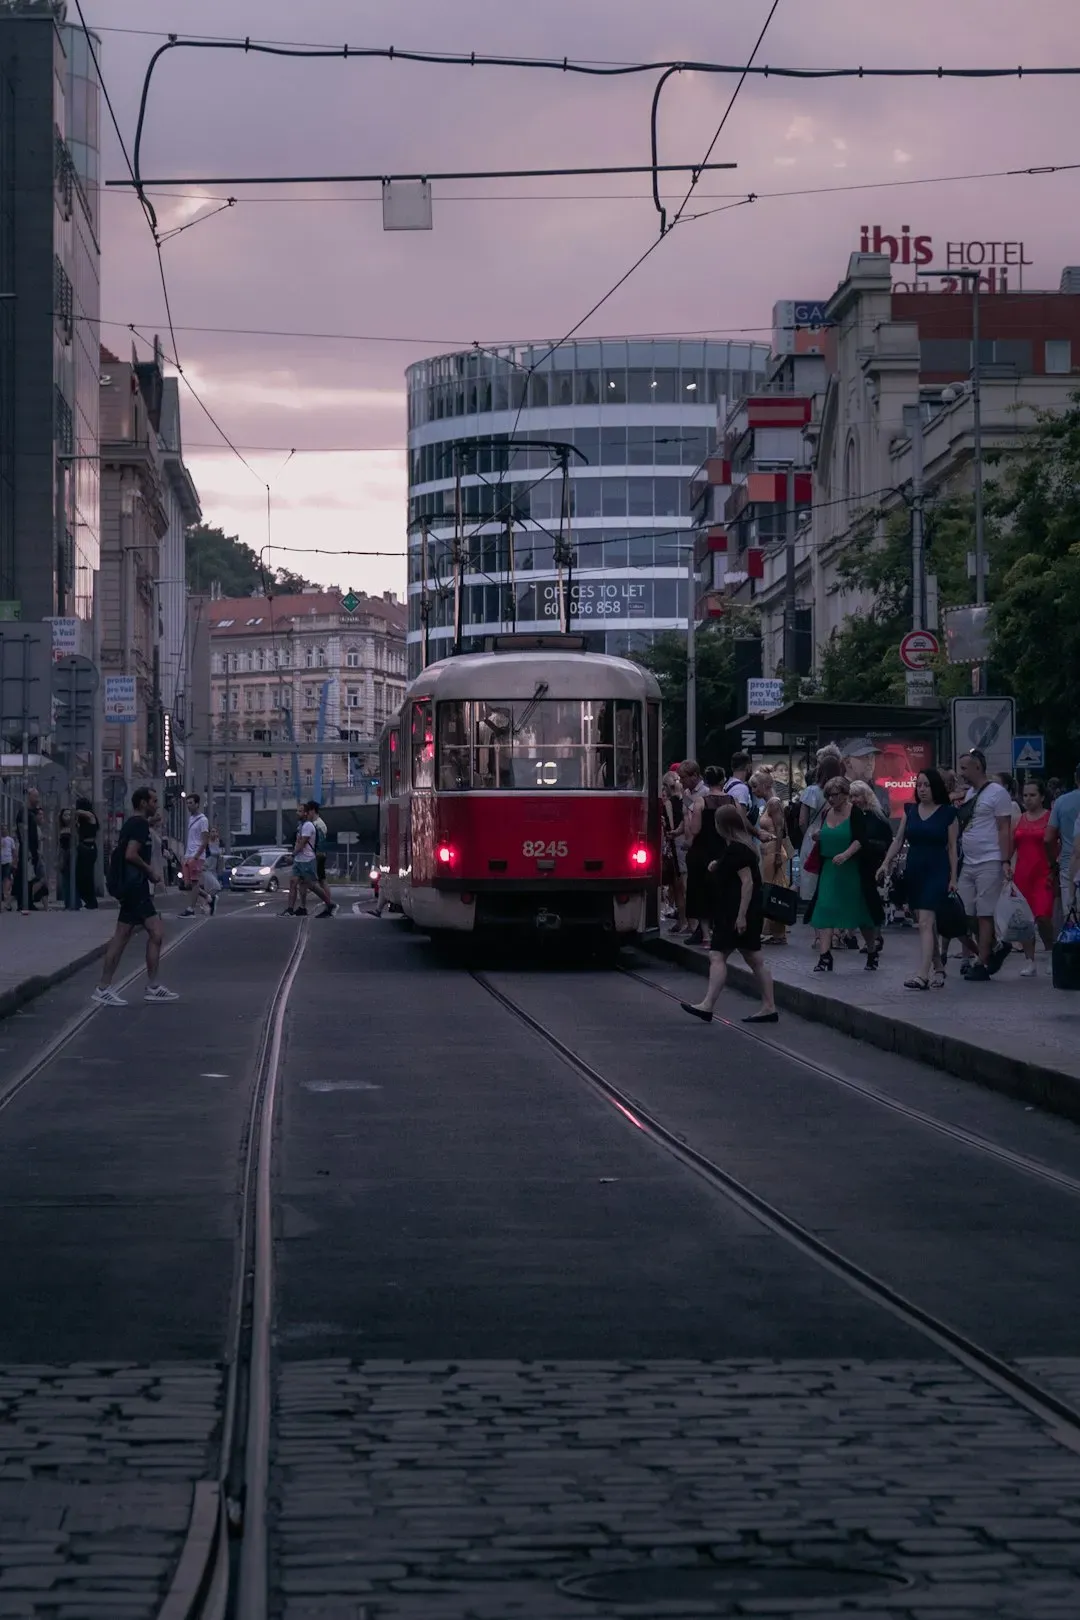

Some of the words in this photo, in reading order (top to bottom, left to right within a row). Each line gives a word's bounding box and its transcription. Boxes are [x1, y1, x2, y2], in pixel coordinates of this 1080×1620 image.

[860, 225, 934, 265] ibis
[946, 241, 1034, 265] HOTEL
[543, 585, 595, 600] OFFCES
[597, 585, 618, 599] TO
[621, 584, 646, 598] LET
[569, 601, 594, 615] 056
[597, 600, 622, 614] 858
[750, 691, 764, 699] pro
[535, 761, 559, 785] 10
[522, 840, 570, 858] 8245
